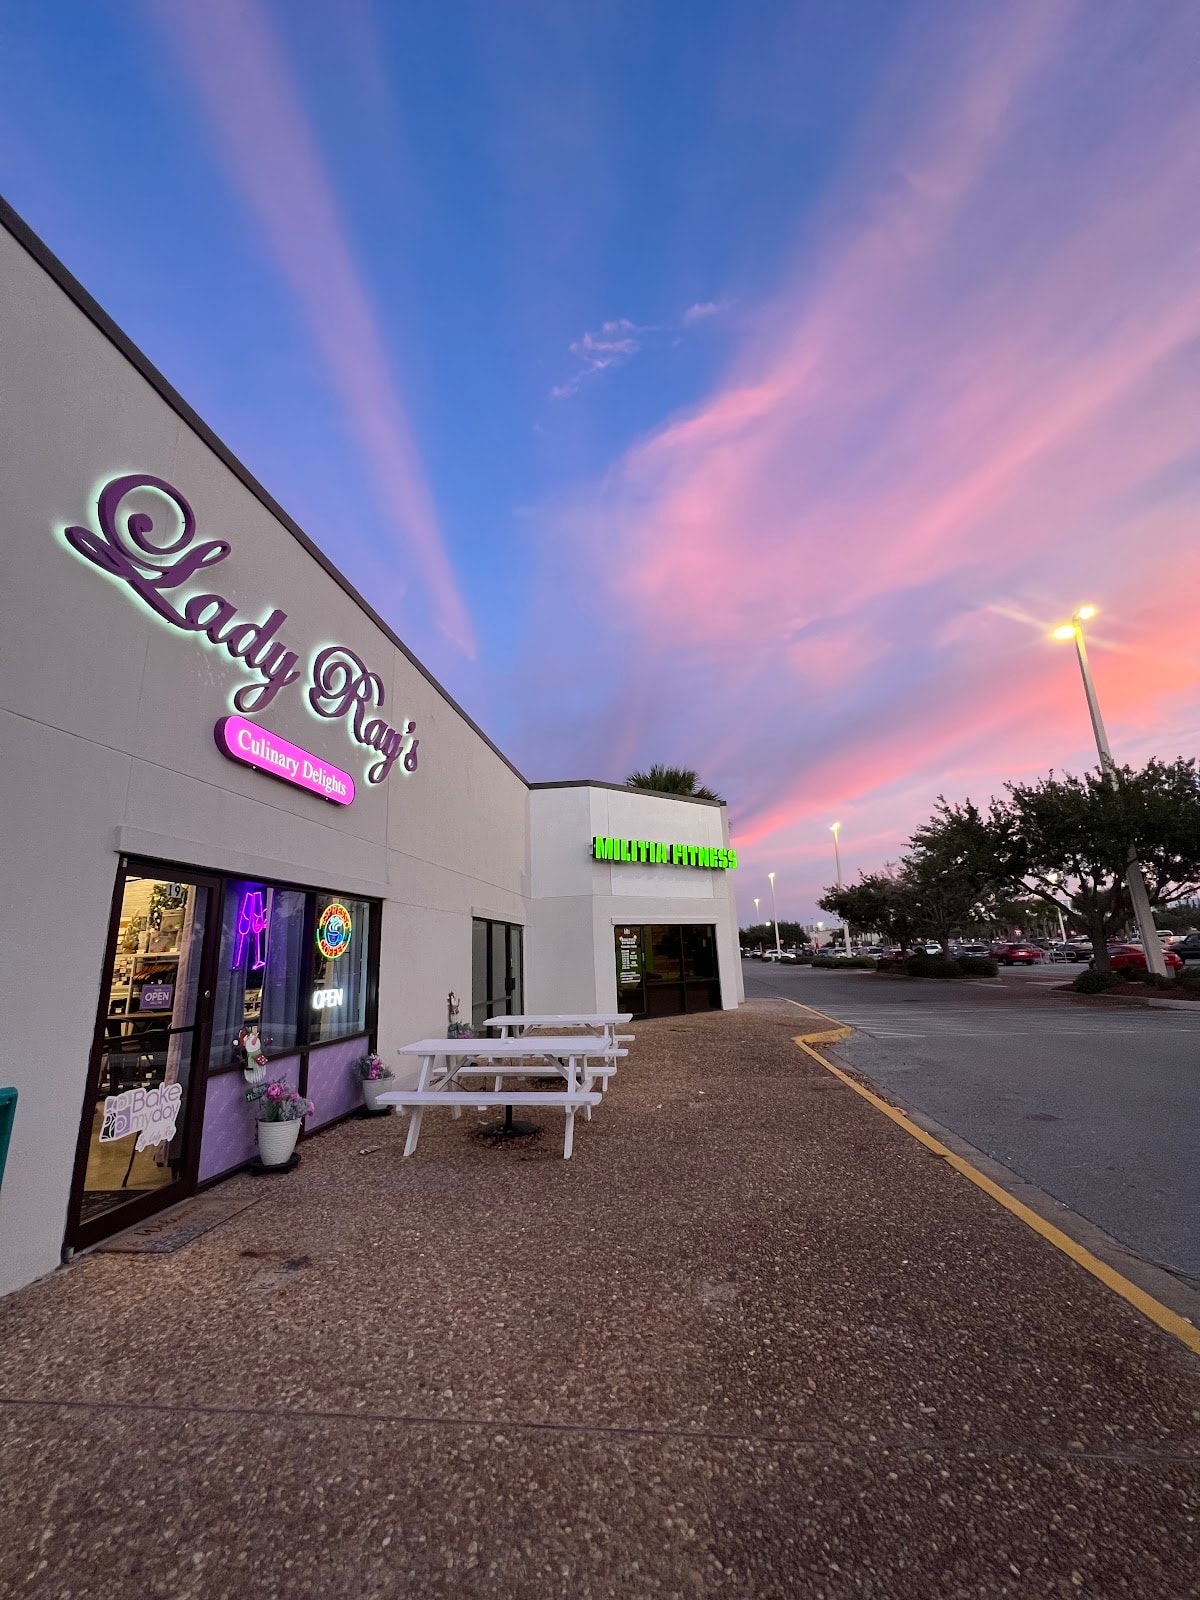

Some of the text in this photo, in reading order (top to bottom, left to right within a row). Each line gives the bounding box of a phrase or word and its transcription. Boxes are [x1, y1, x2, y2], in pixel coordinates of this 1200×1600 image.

[64, 474, 419, 784] Lady Ray's
[238, 729, 347, 796] Culinary Delights
[593, 836, 738, 869] MILITIA FITNESS
[167, 884, 181, 897] 19
[320, 938, 346, 957] COFFEE
[144, 991, 170, 1002] OPEN
[312, 987, 344, 1010] OPEN
[132, 1085, 181, 1113] Bake
[151, 1102, 179, 1123] day
